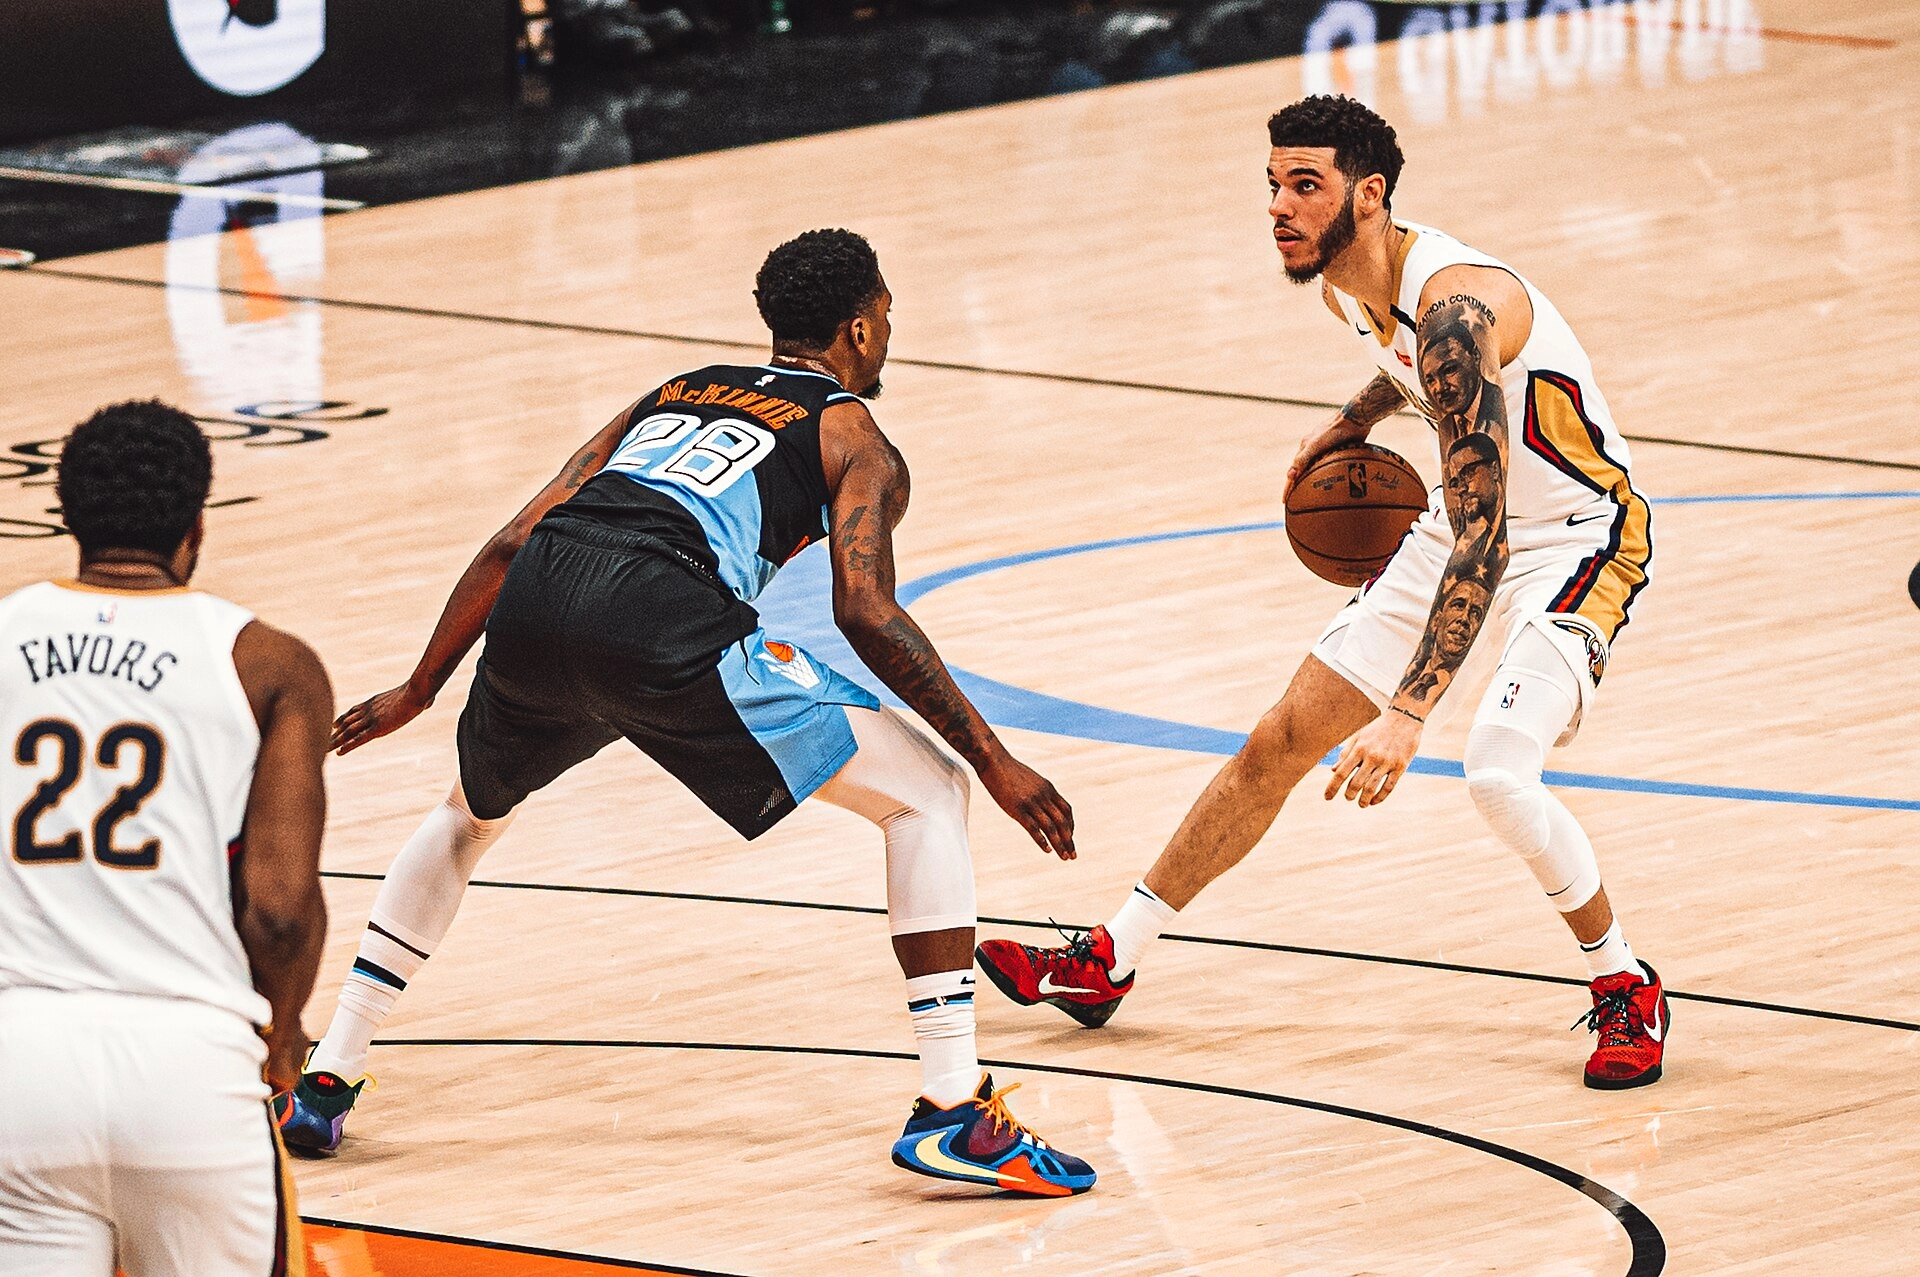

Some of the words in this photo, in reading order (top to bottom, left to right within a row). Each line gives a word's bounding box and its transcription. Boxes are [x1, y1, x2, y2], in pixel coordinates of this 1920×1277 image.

[1449, 293, 1497, 327] CONTINUES
[603, 412, 777, 499] 28
[19, 633, 177, 692] FAVORS
[11, 713, 169, 872] 22
